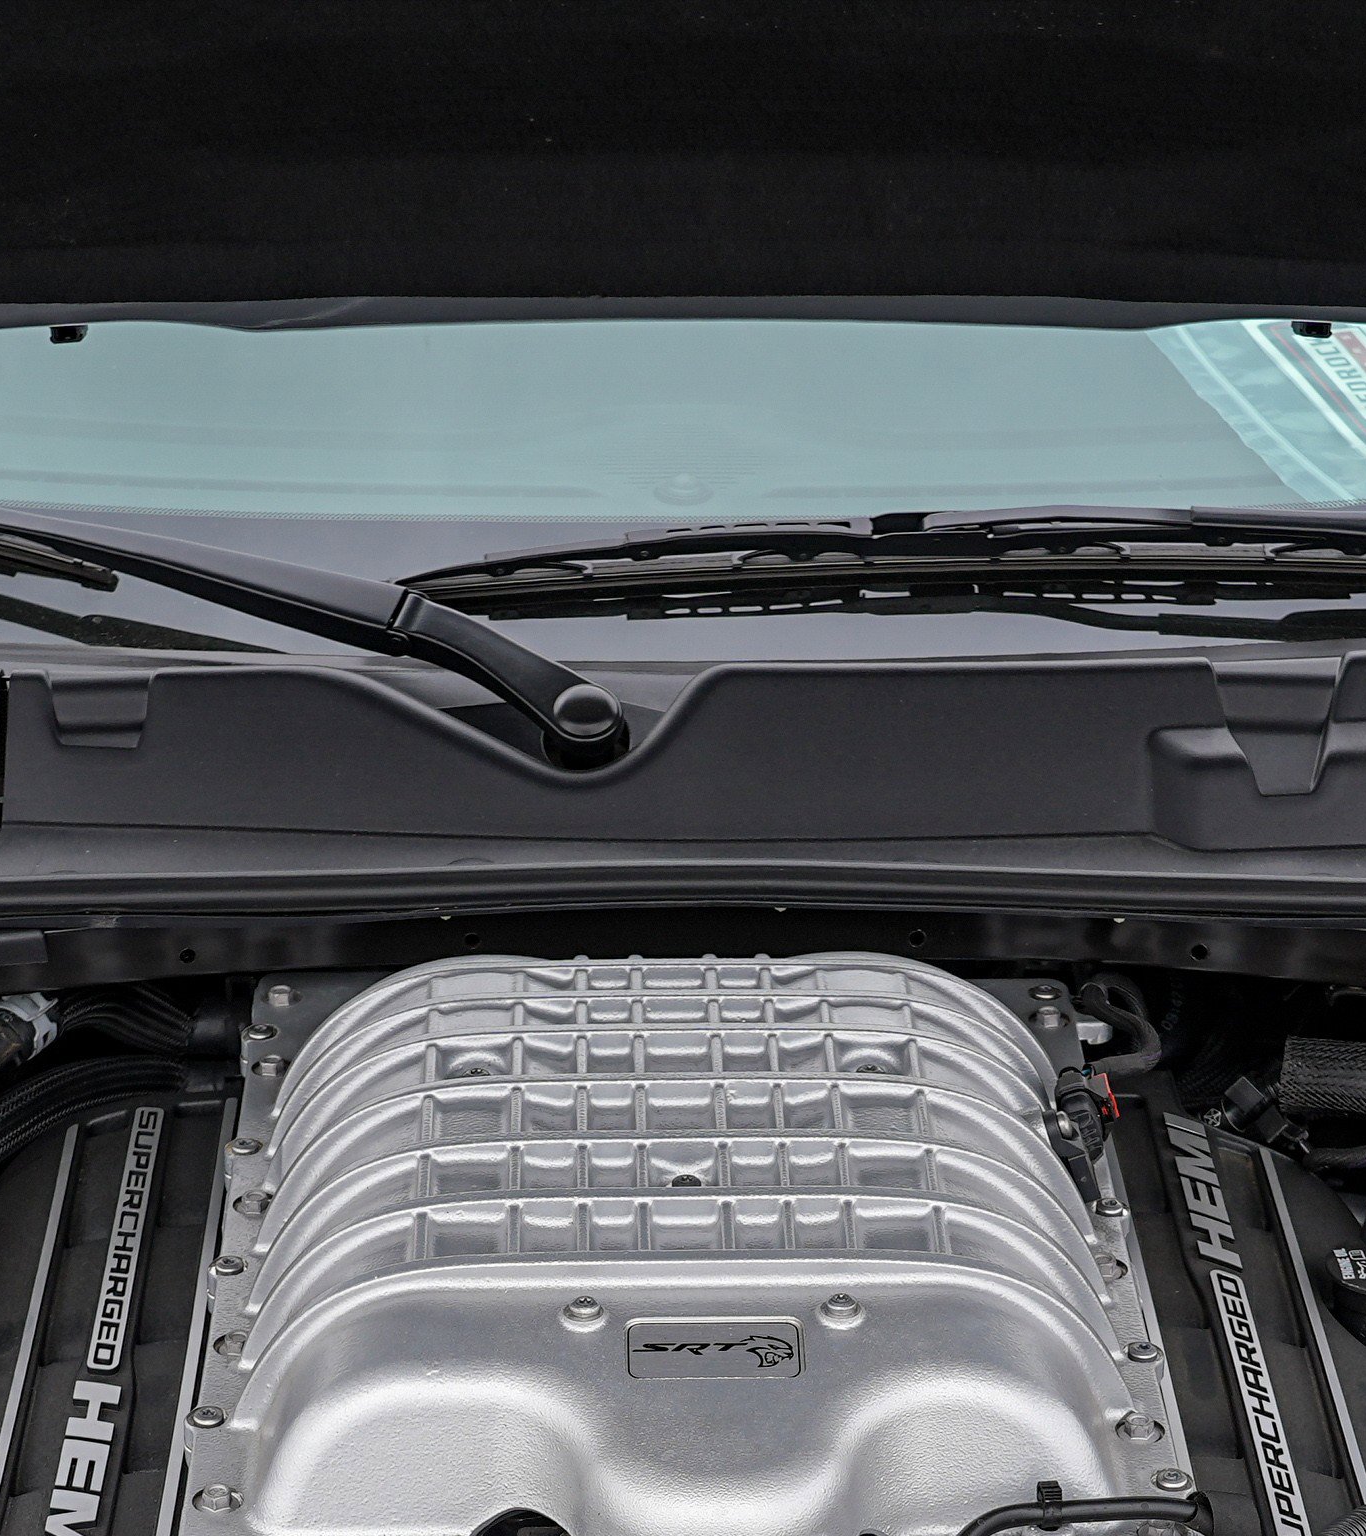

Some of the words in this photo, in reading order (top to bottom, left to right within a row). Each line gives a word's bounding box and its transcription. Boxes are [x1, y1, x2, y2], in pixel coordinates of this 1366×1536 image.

[92, 1110, 158, 1366] SUPERCHARGED
[1163, 1113, 1242, 1270] HEMI
[632, 1342, 748, 1355] SRT
